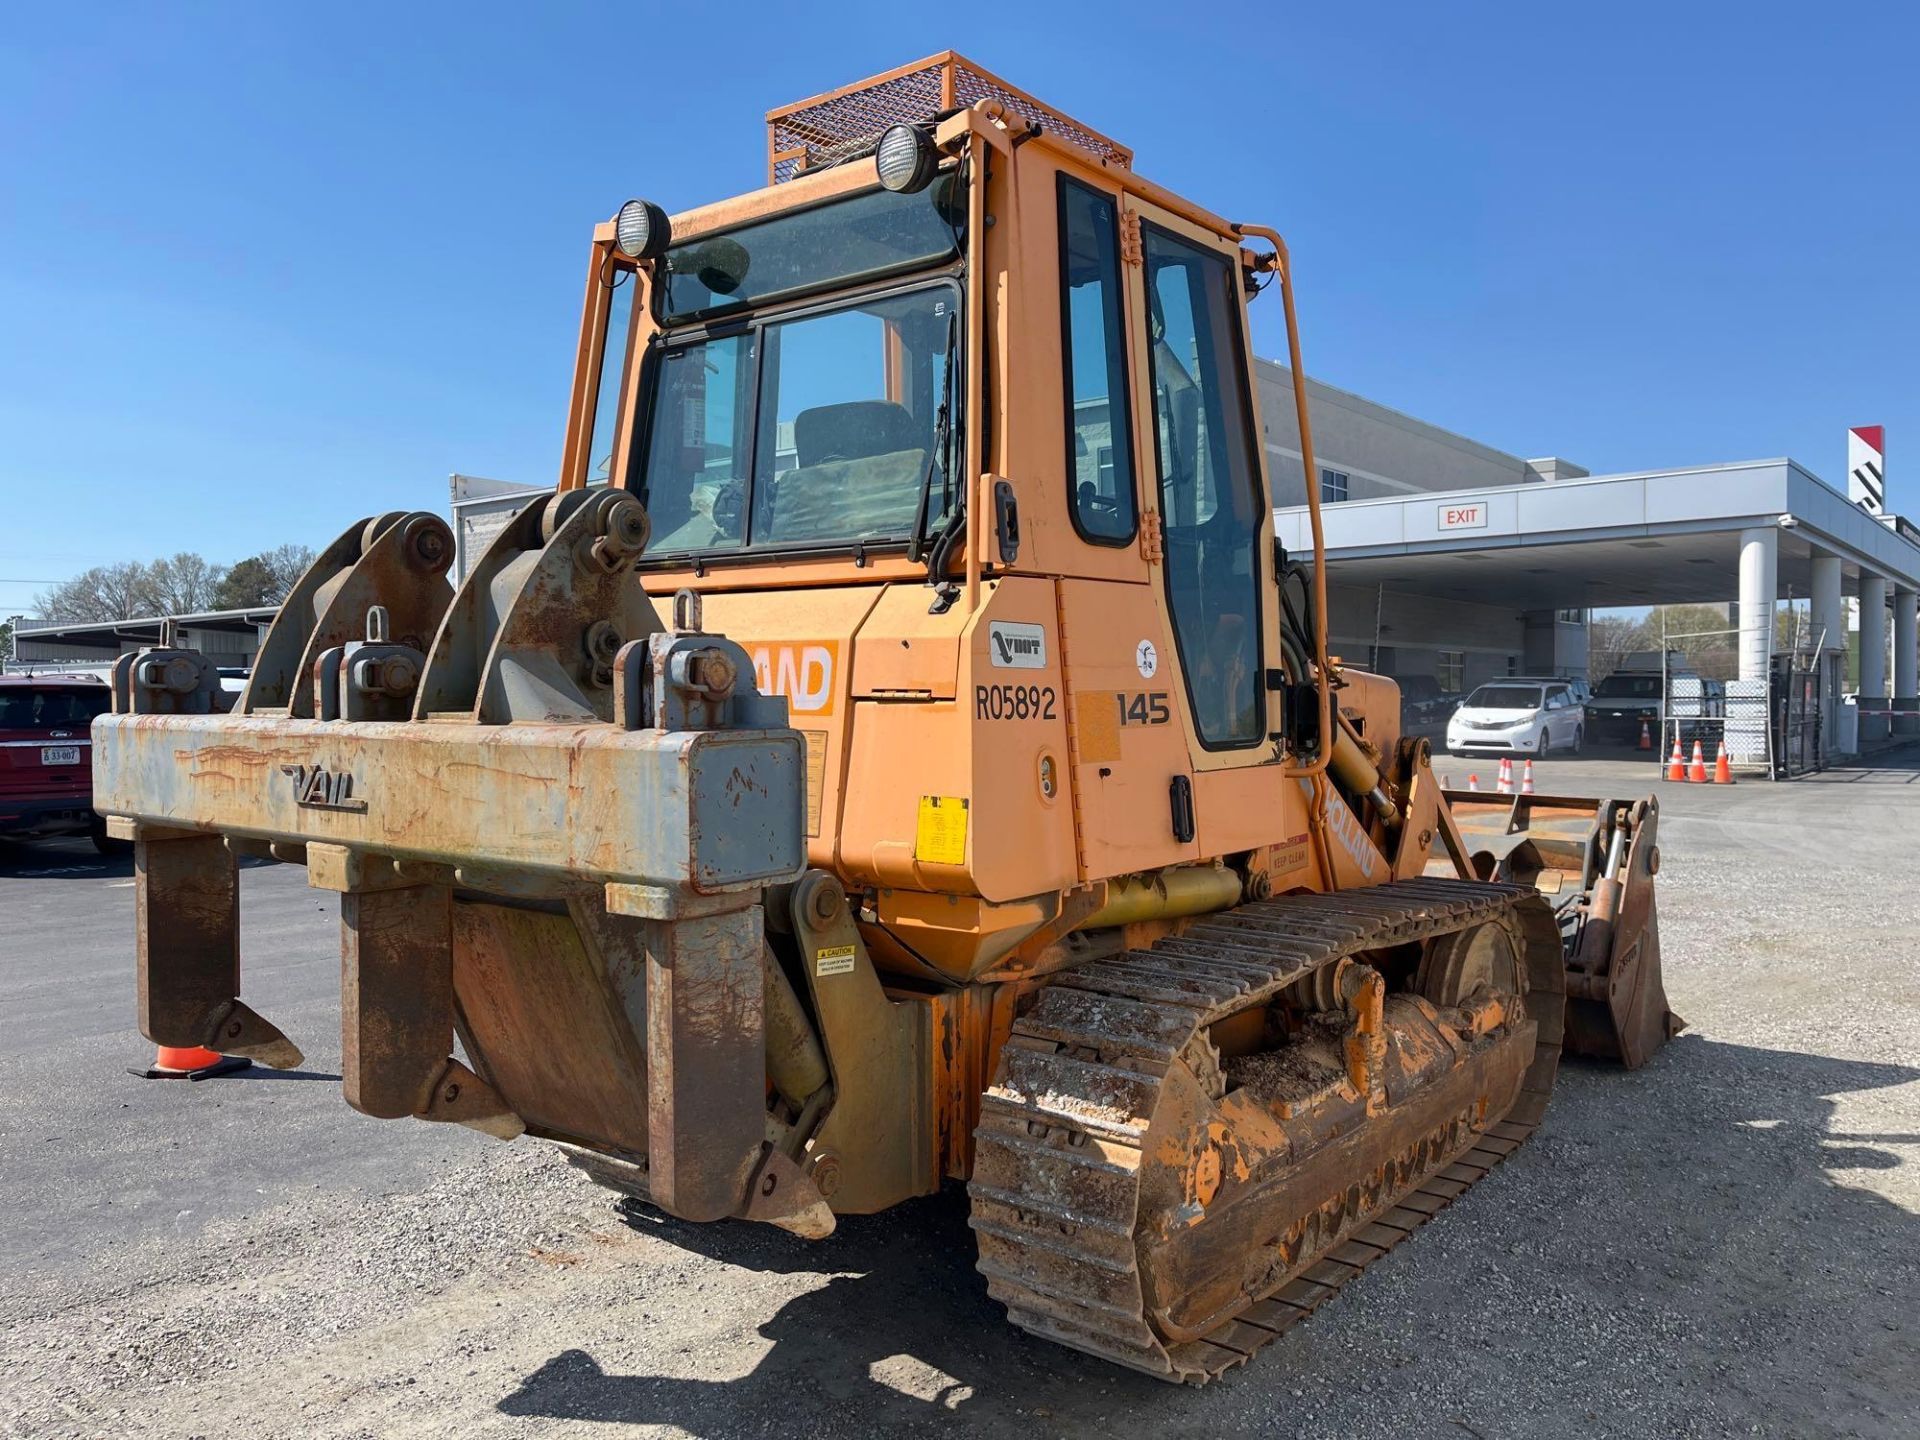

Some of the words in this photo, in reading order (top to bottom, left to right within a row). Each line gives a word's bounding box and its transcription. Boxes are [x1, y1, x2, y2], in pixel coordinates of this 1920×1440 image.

[1447, 509, 1478, 524] EXIT
[975, 685, 1057, 720] R05892
[1117, 693, 1170, 726] 145
[280, 763, 369, 815] VAIL
[827, 947, 852, 956] CAUTION
